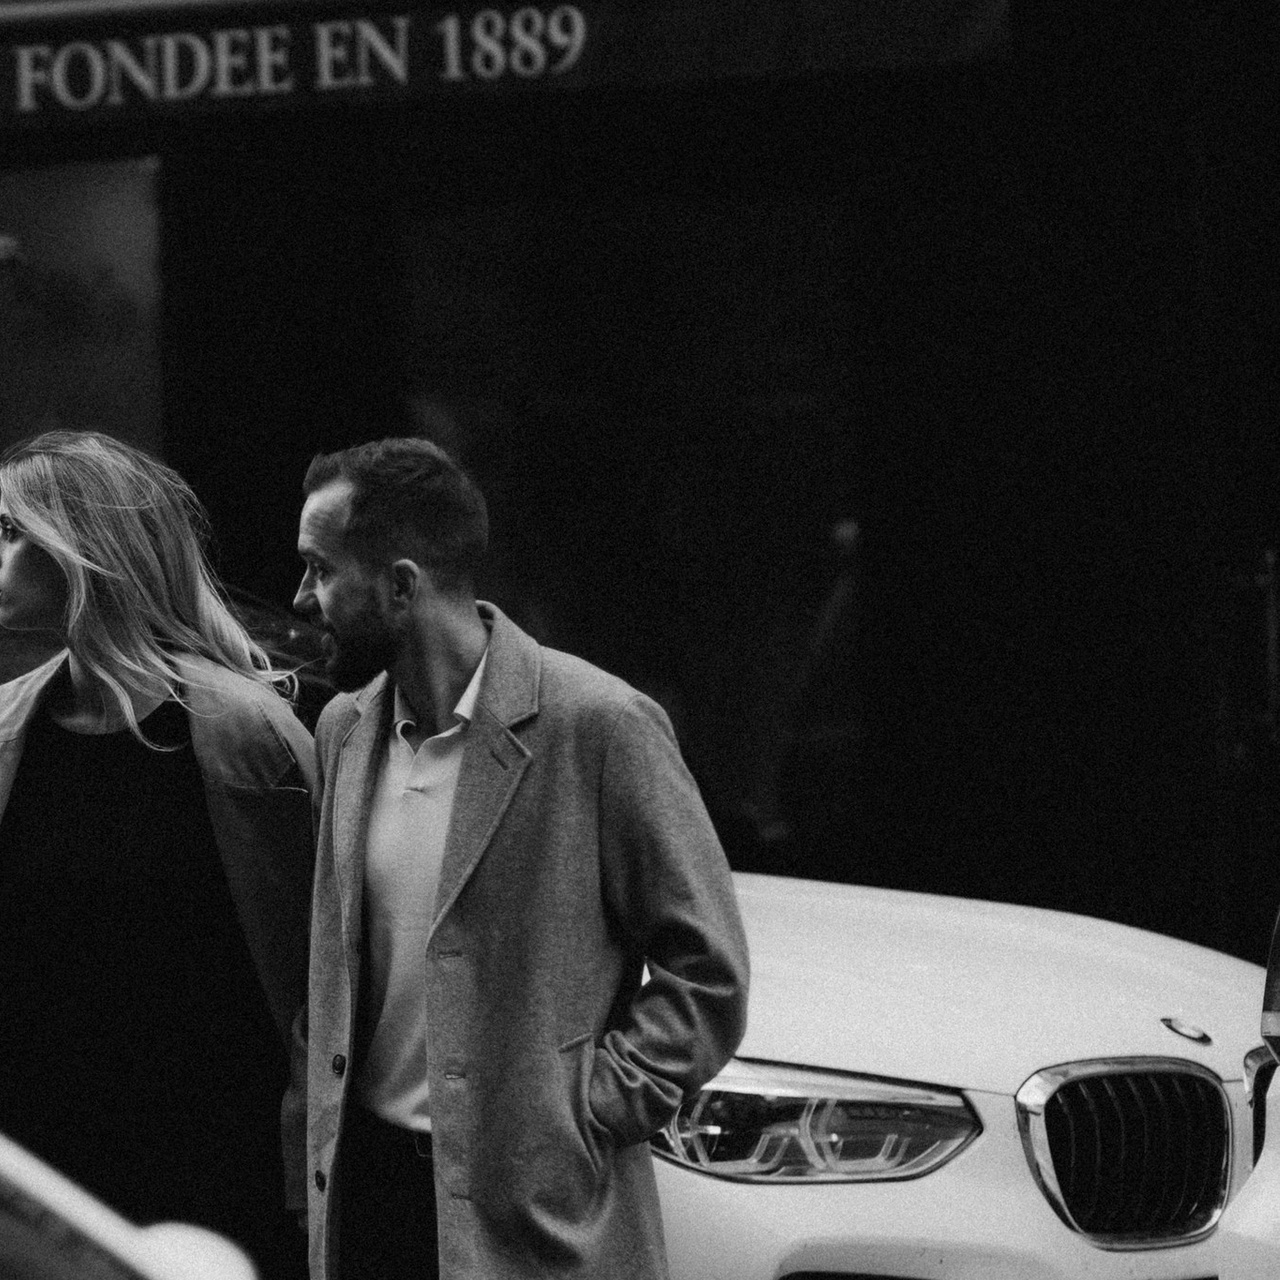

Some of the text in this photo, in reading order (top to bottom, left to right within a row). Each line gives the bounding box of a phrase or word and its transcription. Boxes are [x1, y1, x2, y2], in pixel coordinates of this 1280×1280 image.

[16, 25, 293, 113] FONDEE
[314, 16, 411, 89] EN
[434, 5, 587, 79] 1889
